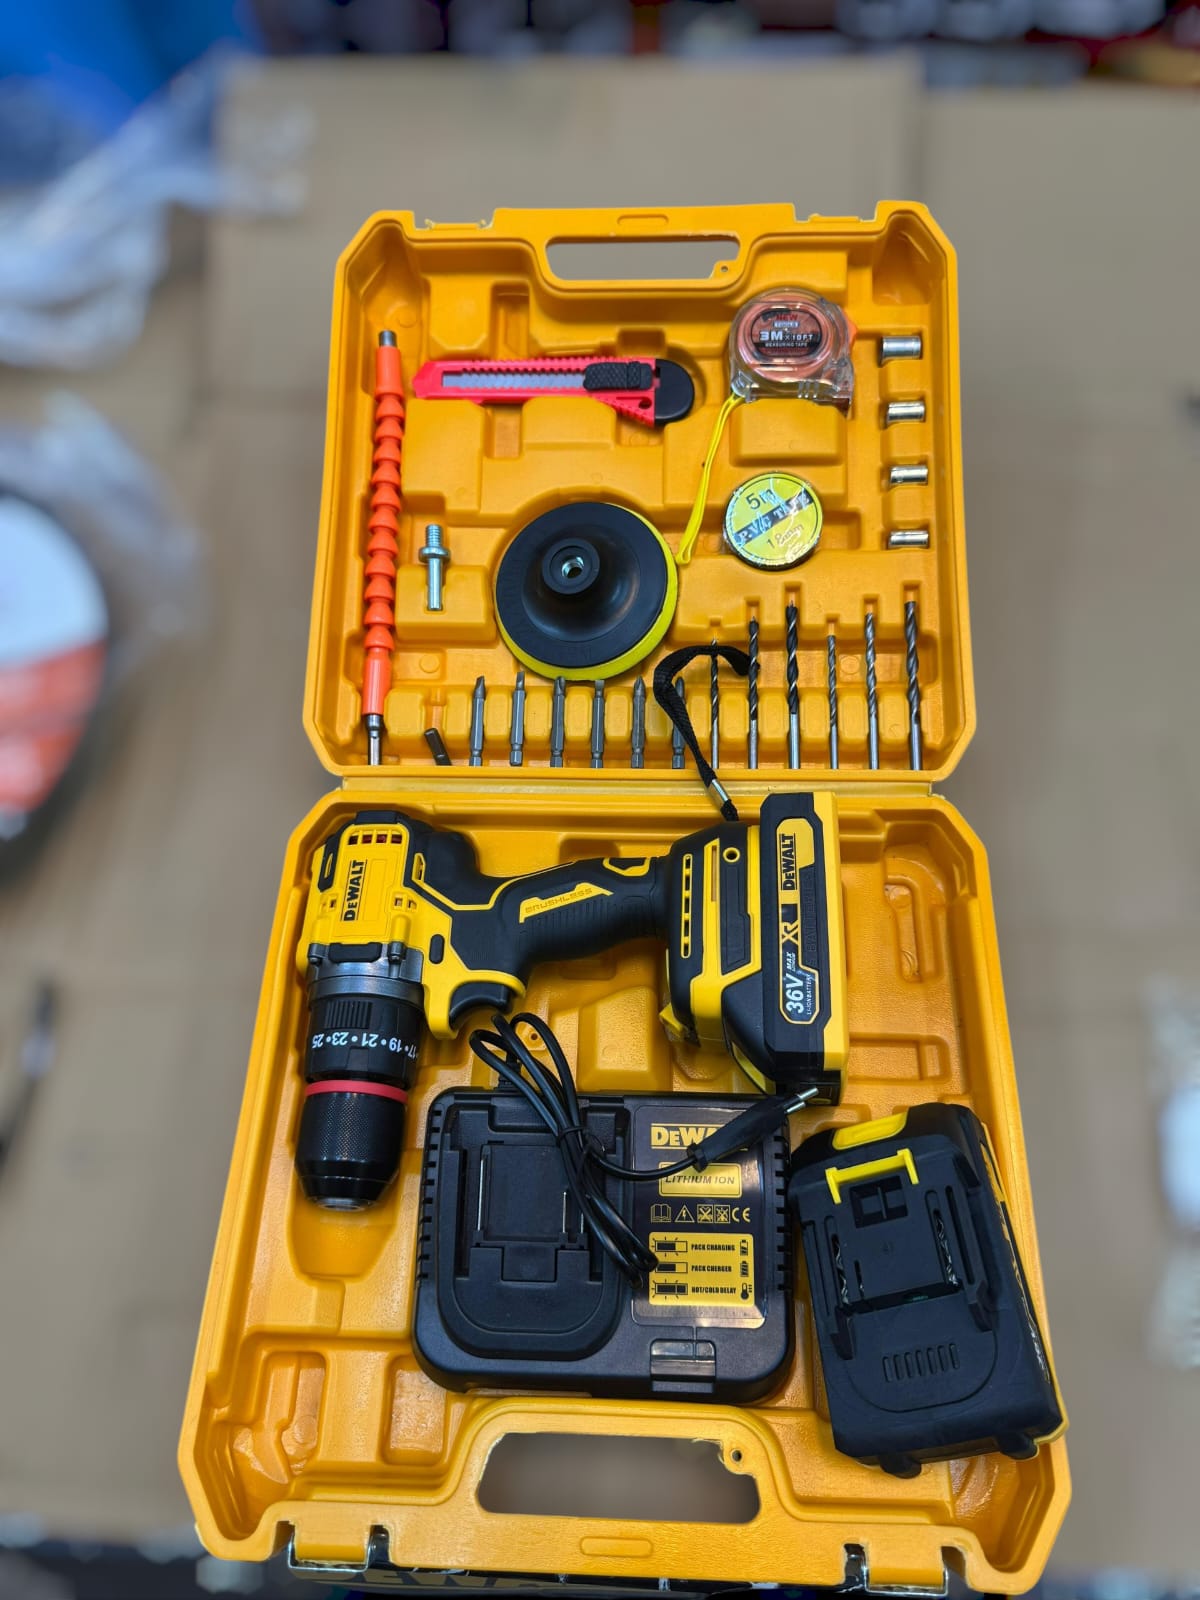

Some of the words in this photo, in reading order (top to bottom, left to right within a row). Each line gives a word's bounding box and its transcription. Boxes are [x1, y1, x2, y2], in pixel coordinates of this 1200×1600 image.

[760, 330, 783, 341] 3M
[781, 833, 796, 891] DEWALT
[344, 860, 365, 921] DEWALT
[525, 888, 593, 913] BRUSHLESS
[785, 972, 804, 1013] 36V
[310, 1032, 324, 1048] 25
[331, 1030, 348, 1045] 23
[361, 1031, 378, 1047] 21
[387, 1036, 402, 1052] 19
[665, 1175, 712, 1184] LITHIUM
[715, 1175, 735, 1184] ION
[691, 1286, 720, 1294] HOT/COLD
